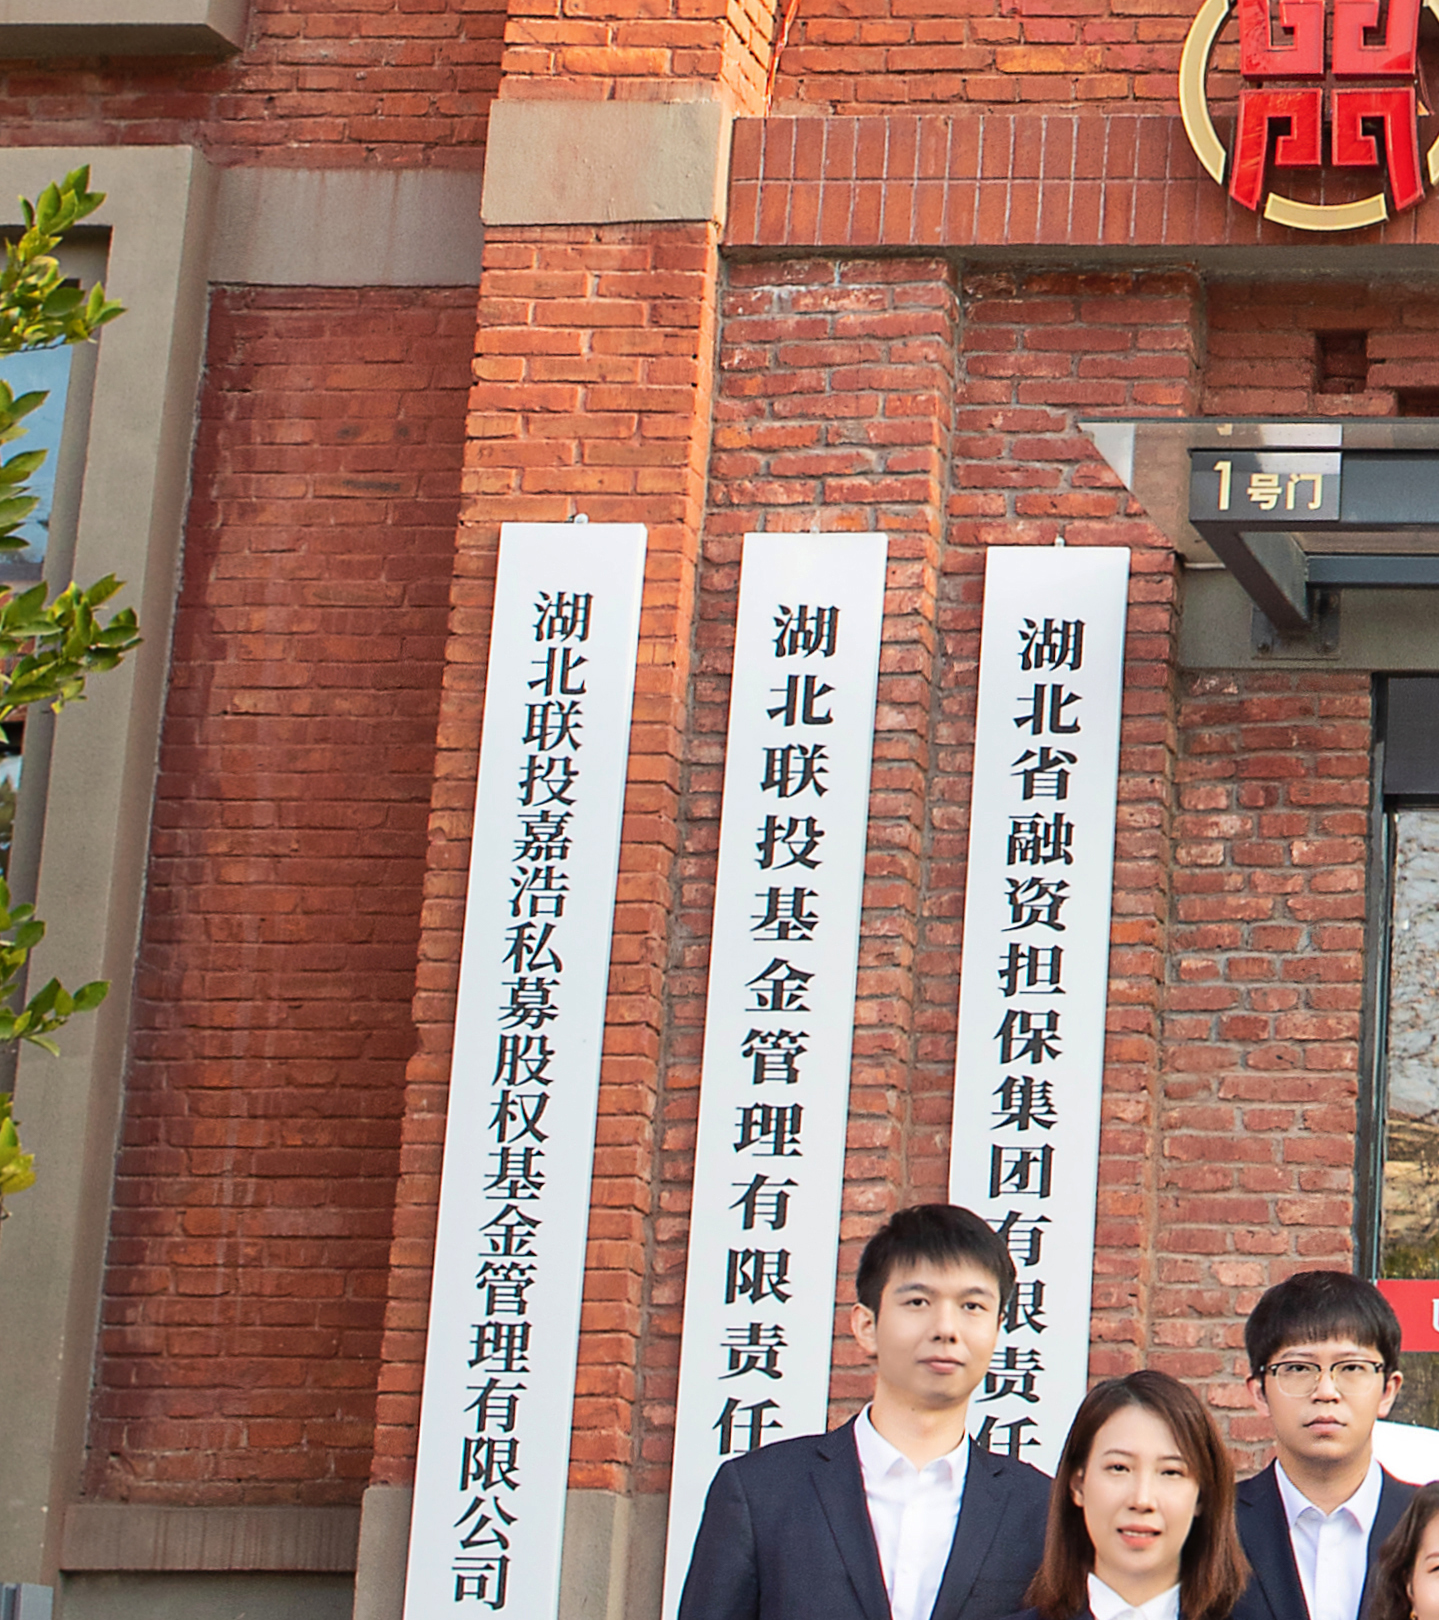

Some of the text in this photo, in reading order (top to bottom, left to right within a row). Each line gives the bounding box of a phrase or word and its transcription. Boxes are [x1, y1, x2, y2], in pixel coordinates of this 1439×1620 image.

[1212, 460, 1323, 511] 1号门
[451, 590, 594, 1612] 湖北联投嘉浩私募股权基金管理有限公司
